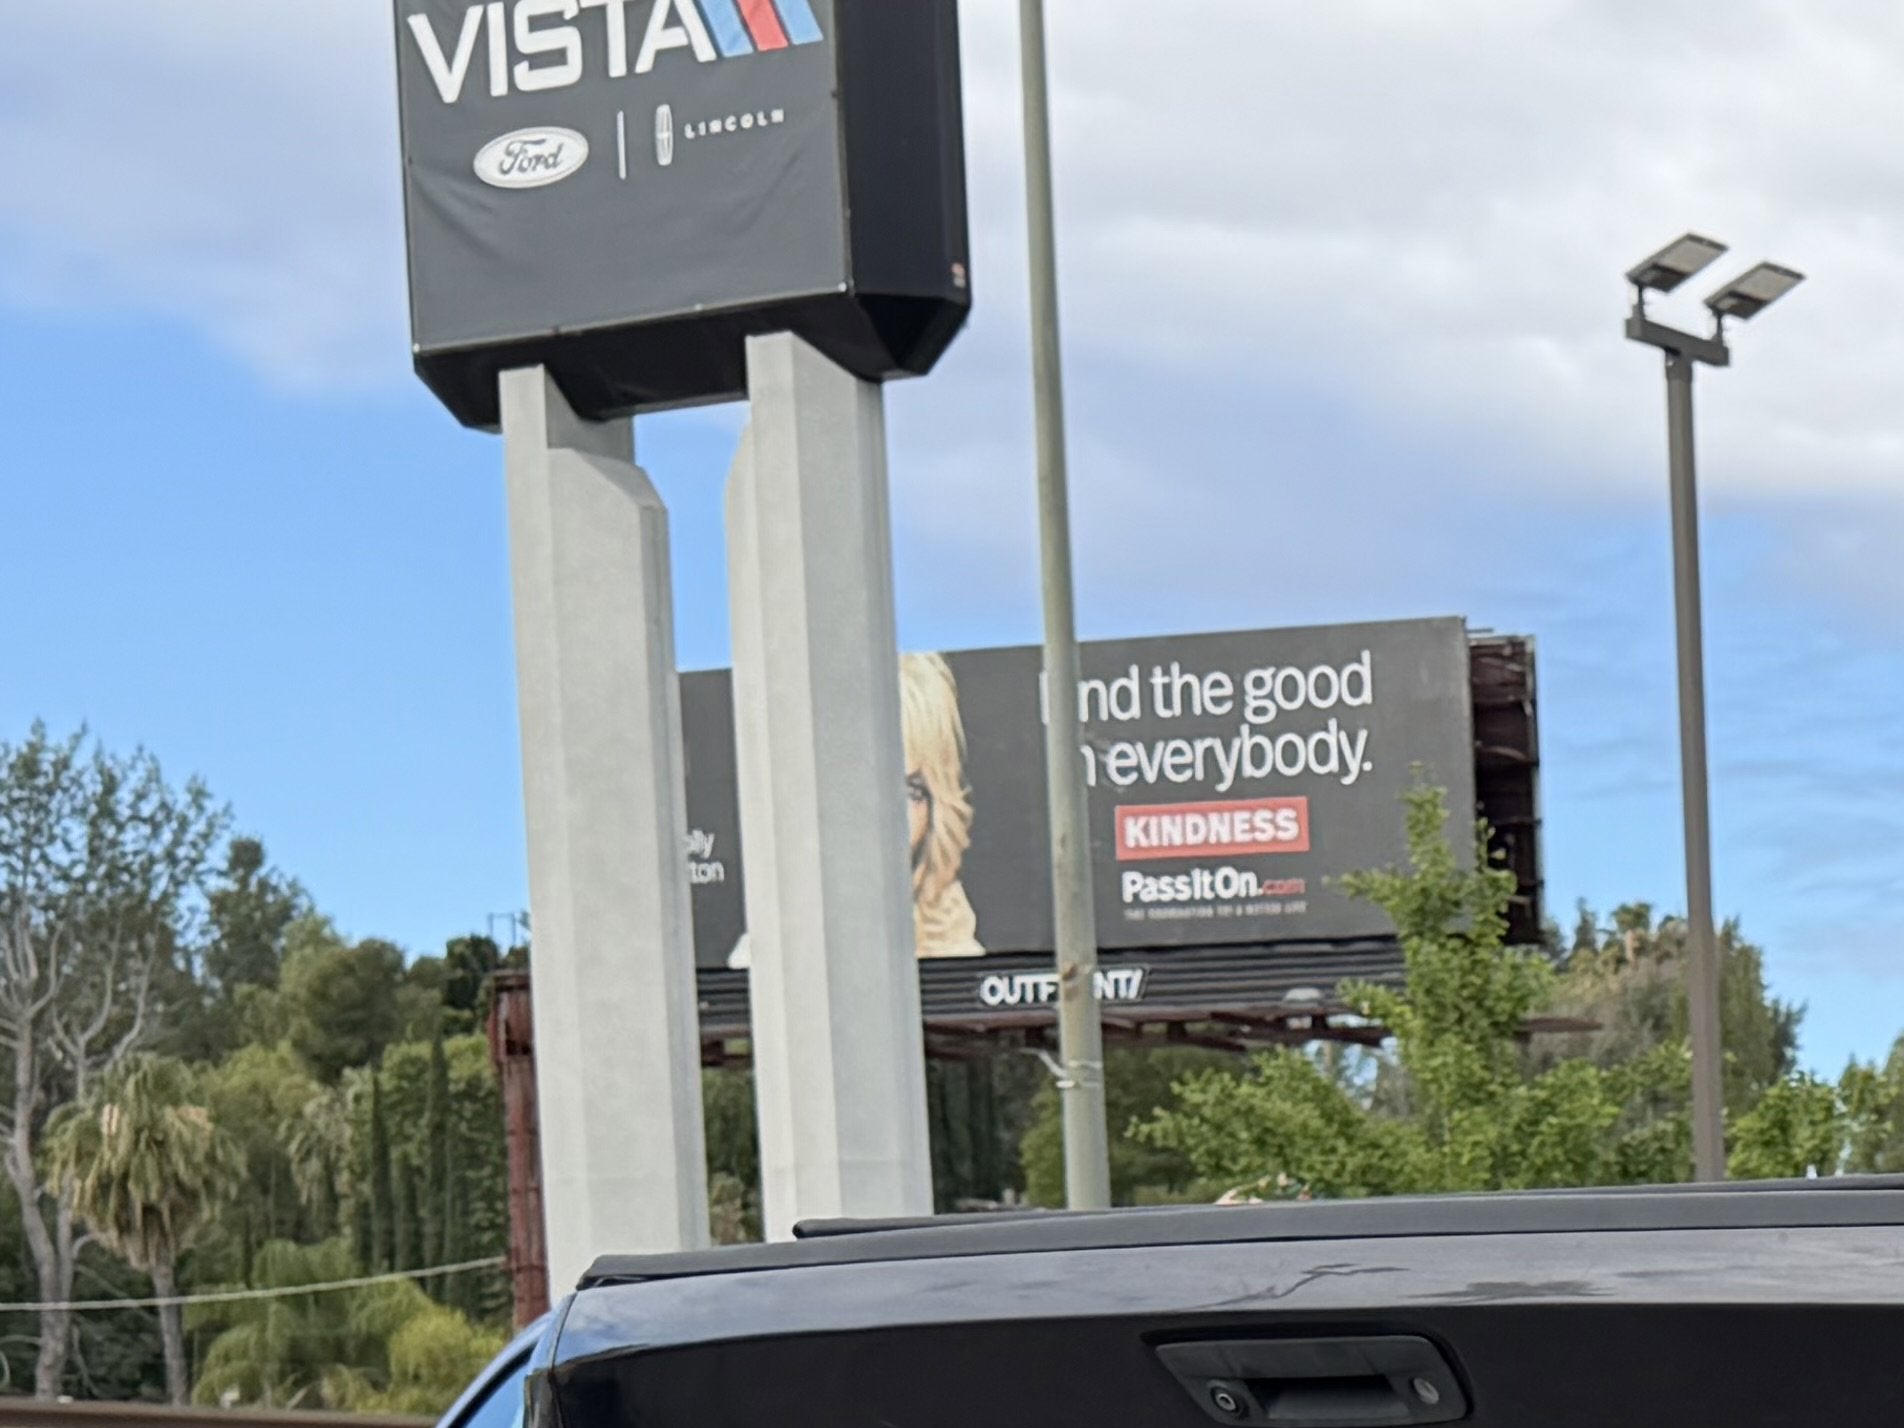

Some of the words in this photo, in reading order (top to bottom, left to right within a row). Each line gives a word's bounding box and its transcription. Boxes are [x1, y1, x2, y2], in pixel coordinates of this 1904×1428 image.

[406, 0, 717, 104] VISTA
[684, 108, 785, 139] LINCOLN
[498, 137, 564, 175] Ford
[1150, 660, 1234, 719] the
[1243, 648, 1373, 725] good
[1104, 716, 1373, 793] everybody.
[1123, 807, 1300, 849] KINDNESS
